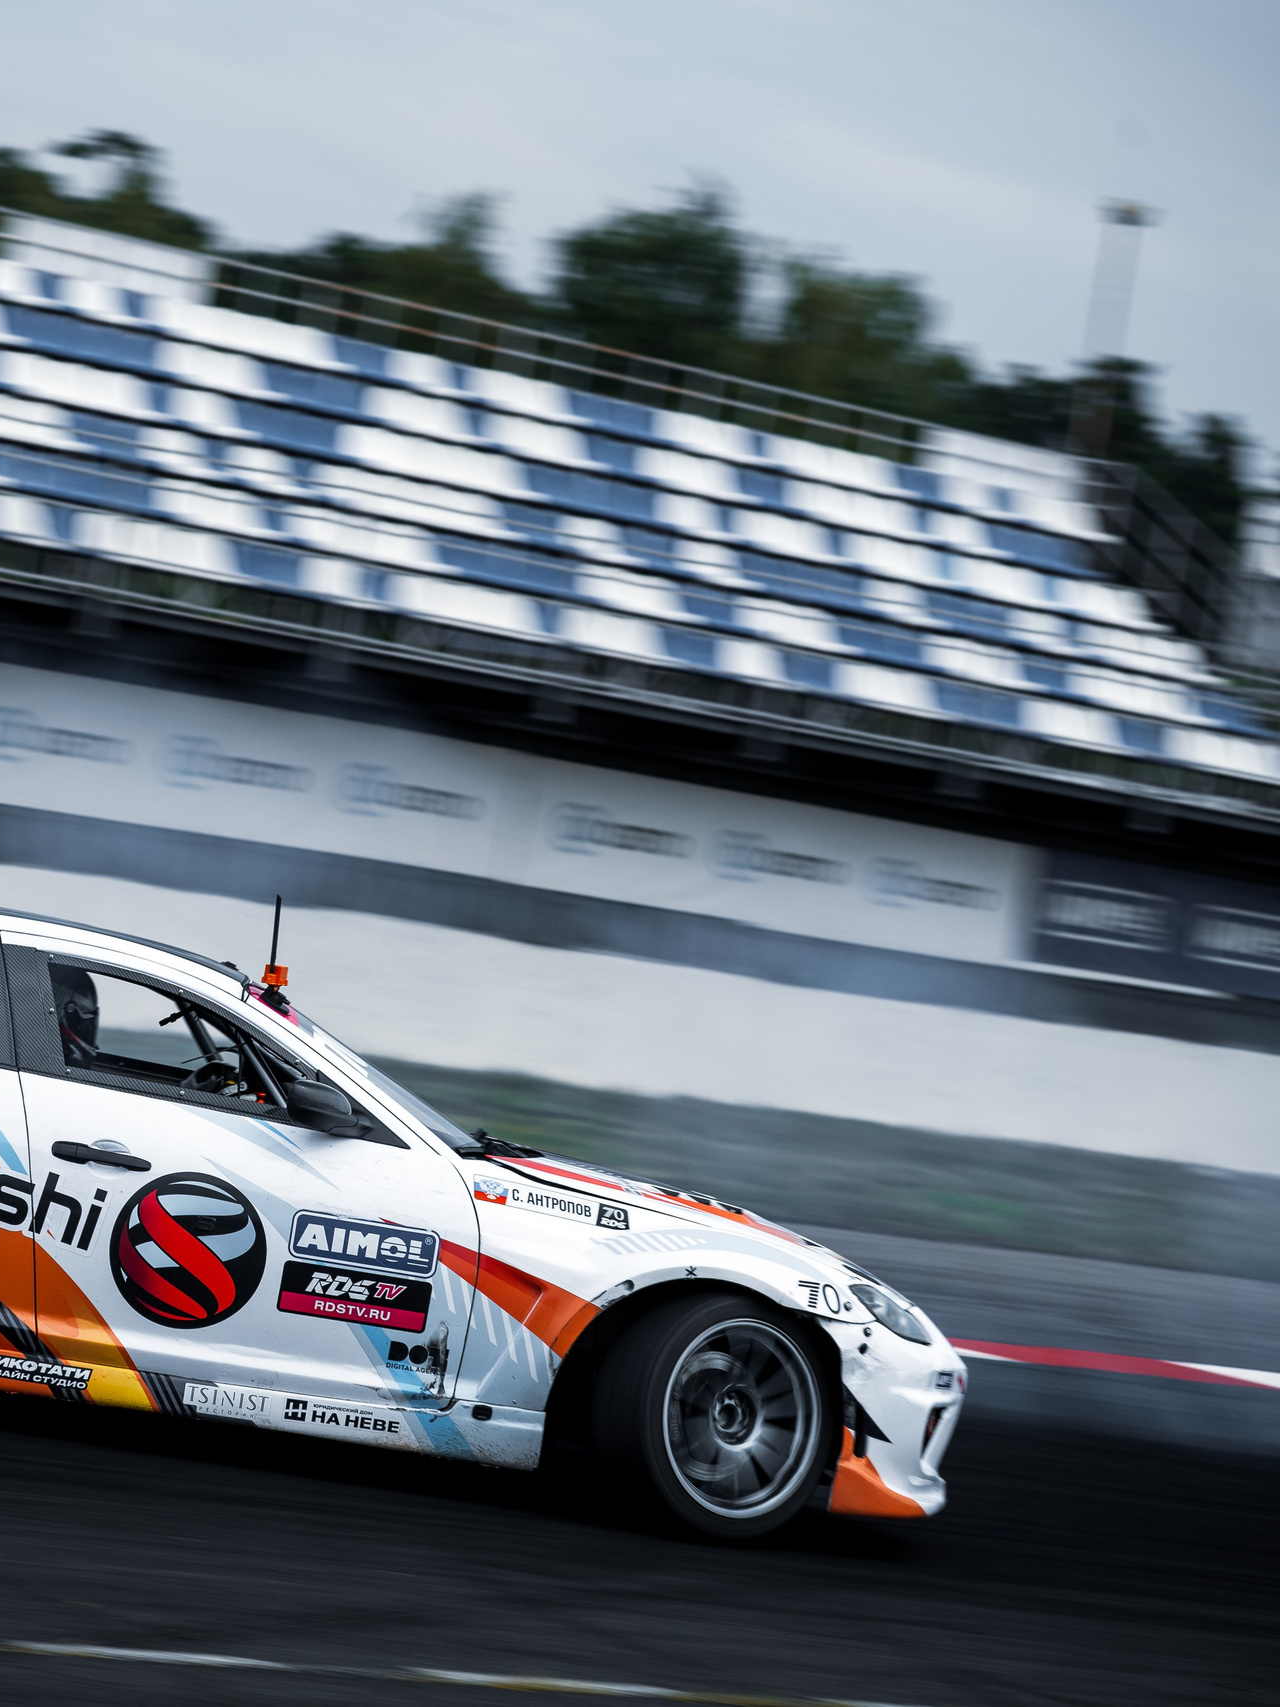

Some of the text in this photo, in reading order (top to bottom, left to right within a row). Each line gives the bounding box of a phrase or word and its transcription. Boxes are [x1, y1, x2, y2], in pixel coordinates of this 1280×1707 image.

[512, 1188, 592, 1217] С. АНТРОПОВ
[602, 1206, 625, 1221] 70
[600, 1217, 628, 1229] RDS
[297, 1223, 429, 1267] AIMOL
[305, 1272, 407, 1301] RDS TV
[314, 1300, 391, 1321] RDSTV.RU
[386, 1362, 414, 1372] DIGITAL
[33, 1374, 87, 1389] СТУДИО
[198, 1406, 254, 1419] РЕСТОРАН
[313, 1403, 374, 1416] ЮРИДИЧЕСКИЙ ДОМ
[311, 1411, 400, 1434] НА НЕВЕ
